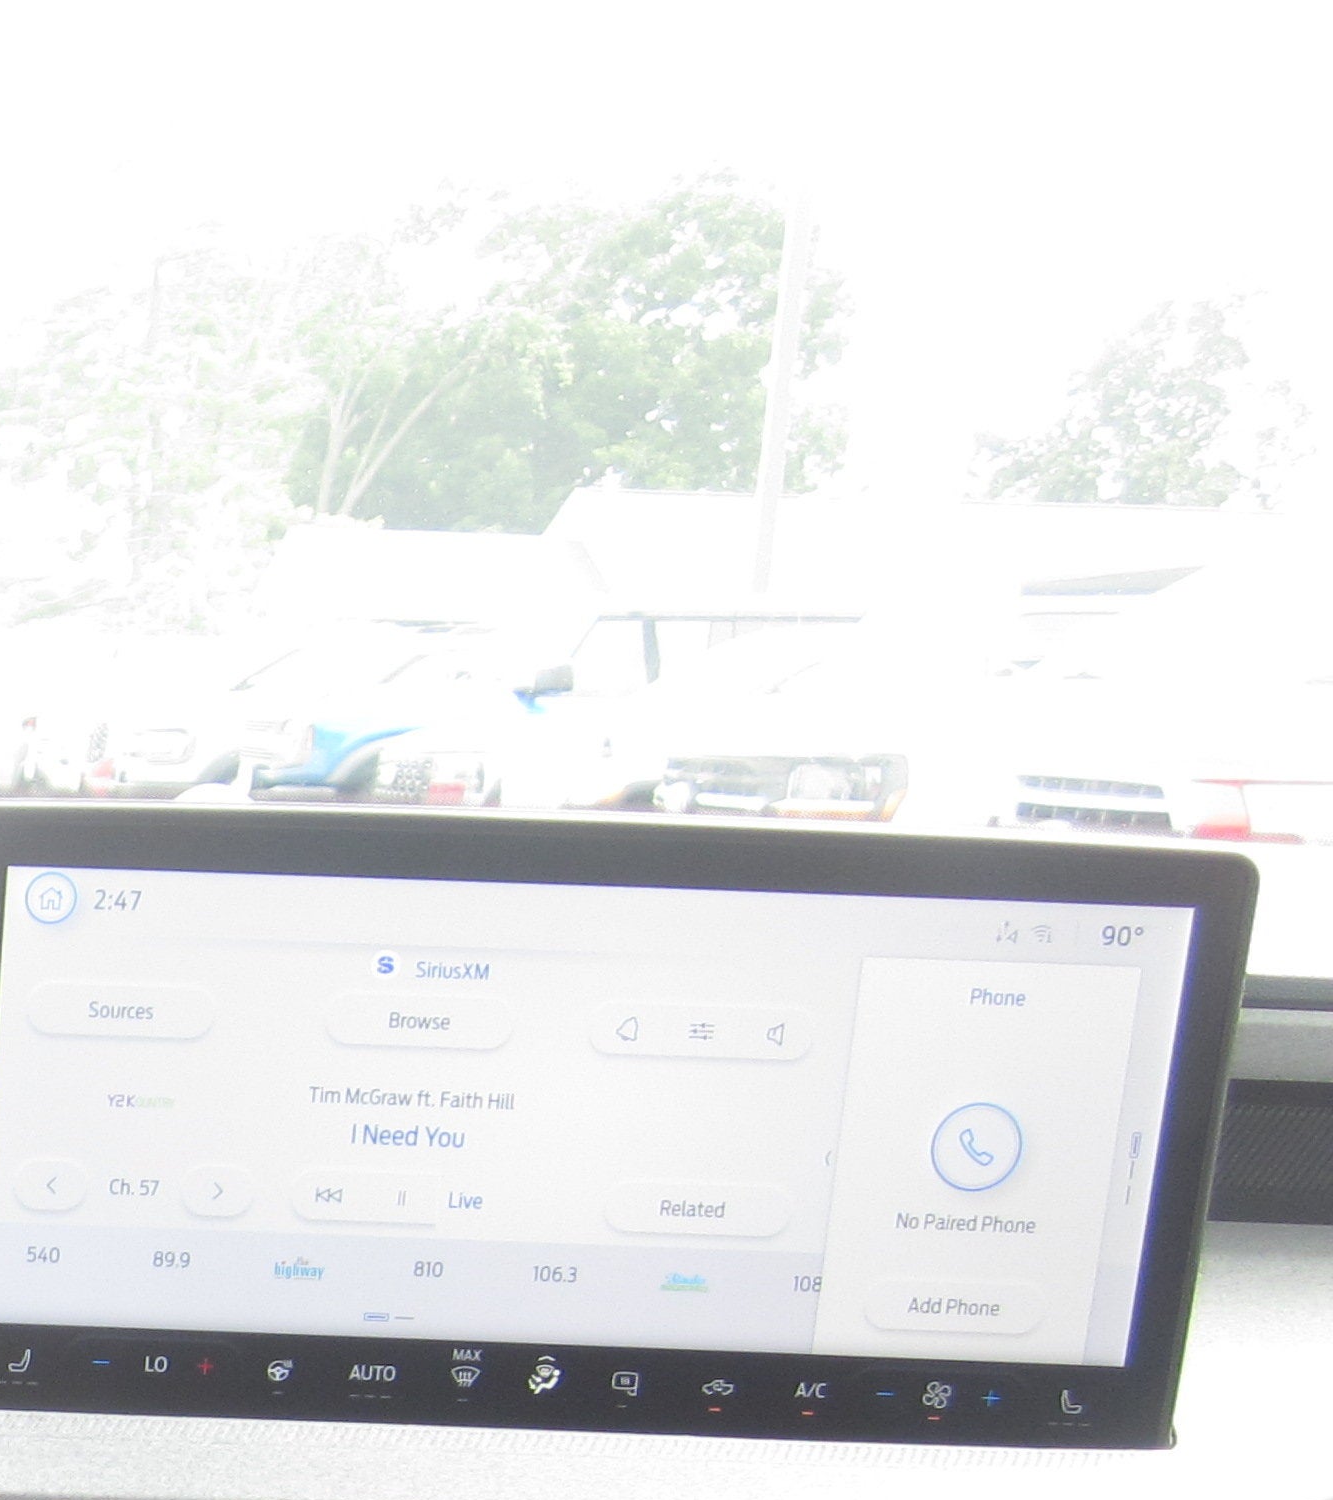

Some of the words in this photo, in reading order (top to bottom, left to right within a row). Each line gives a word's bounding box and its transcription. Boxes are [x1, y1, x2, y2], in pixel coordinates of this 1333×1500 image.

[93, 888, 143, 912] 2:47
[1101, 924, 1145, 947] 90°
[414, 960, 491, 982] SiriusXM
[969, 987, 1027, 1007] Phone
[88, 1001, 154, 1022] Sources
[387, 1010, 451, 1032] Browse
[309, 1085, 341, 1105] Tim
[344, 1087, 413, 1107] McGraw
[417, 1089, 435, 1108] ft.
[439, 1090, 483, 1109] Faith
[487, 1092, 516, 1111] Hill
[350, 1123, 357, 1144] I
[362, 1123, 419, 1147] Need
[425, 1125, 465, 1148] You
[108, 1178, 135, 1196] Ch.
[139, 1179, 160, 1197] 57
[448, 1191, 484, 1210] Live
[659, 1199, 726, 1219] Related
[895, 1212, 920, 1230] No
[923, 1213, 978, 1232] Paired
[980, 1215, 1037, 1234] Phone
[26, 1246, 61, 1264] 540
[151, 1250, 191, 1269] 89.9
[273, 1261, 325, 1280] highway
[413, 1261, 444, 1278] 810
[532, 1265, 578, 1283] 106.3
[907, 1296, 942, 1315] Add
[945, 1298, 1000, 1317] Phone
[143, 1355, 169, 1374] LO
[452, 1348, 482, 1362] MAX
[347, 1363, 397, 1383] AUTO
[793, 1381, 828, 1399] A/C
